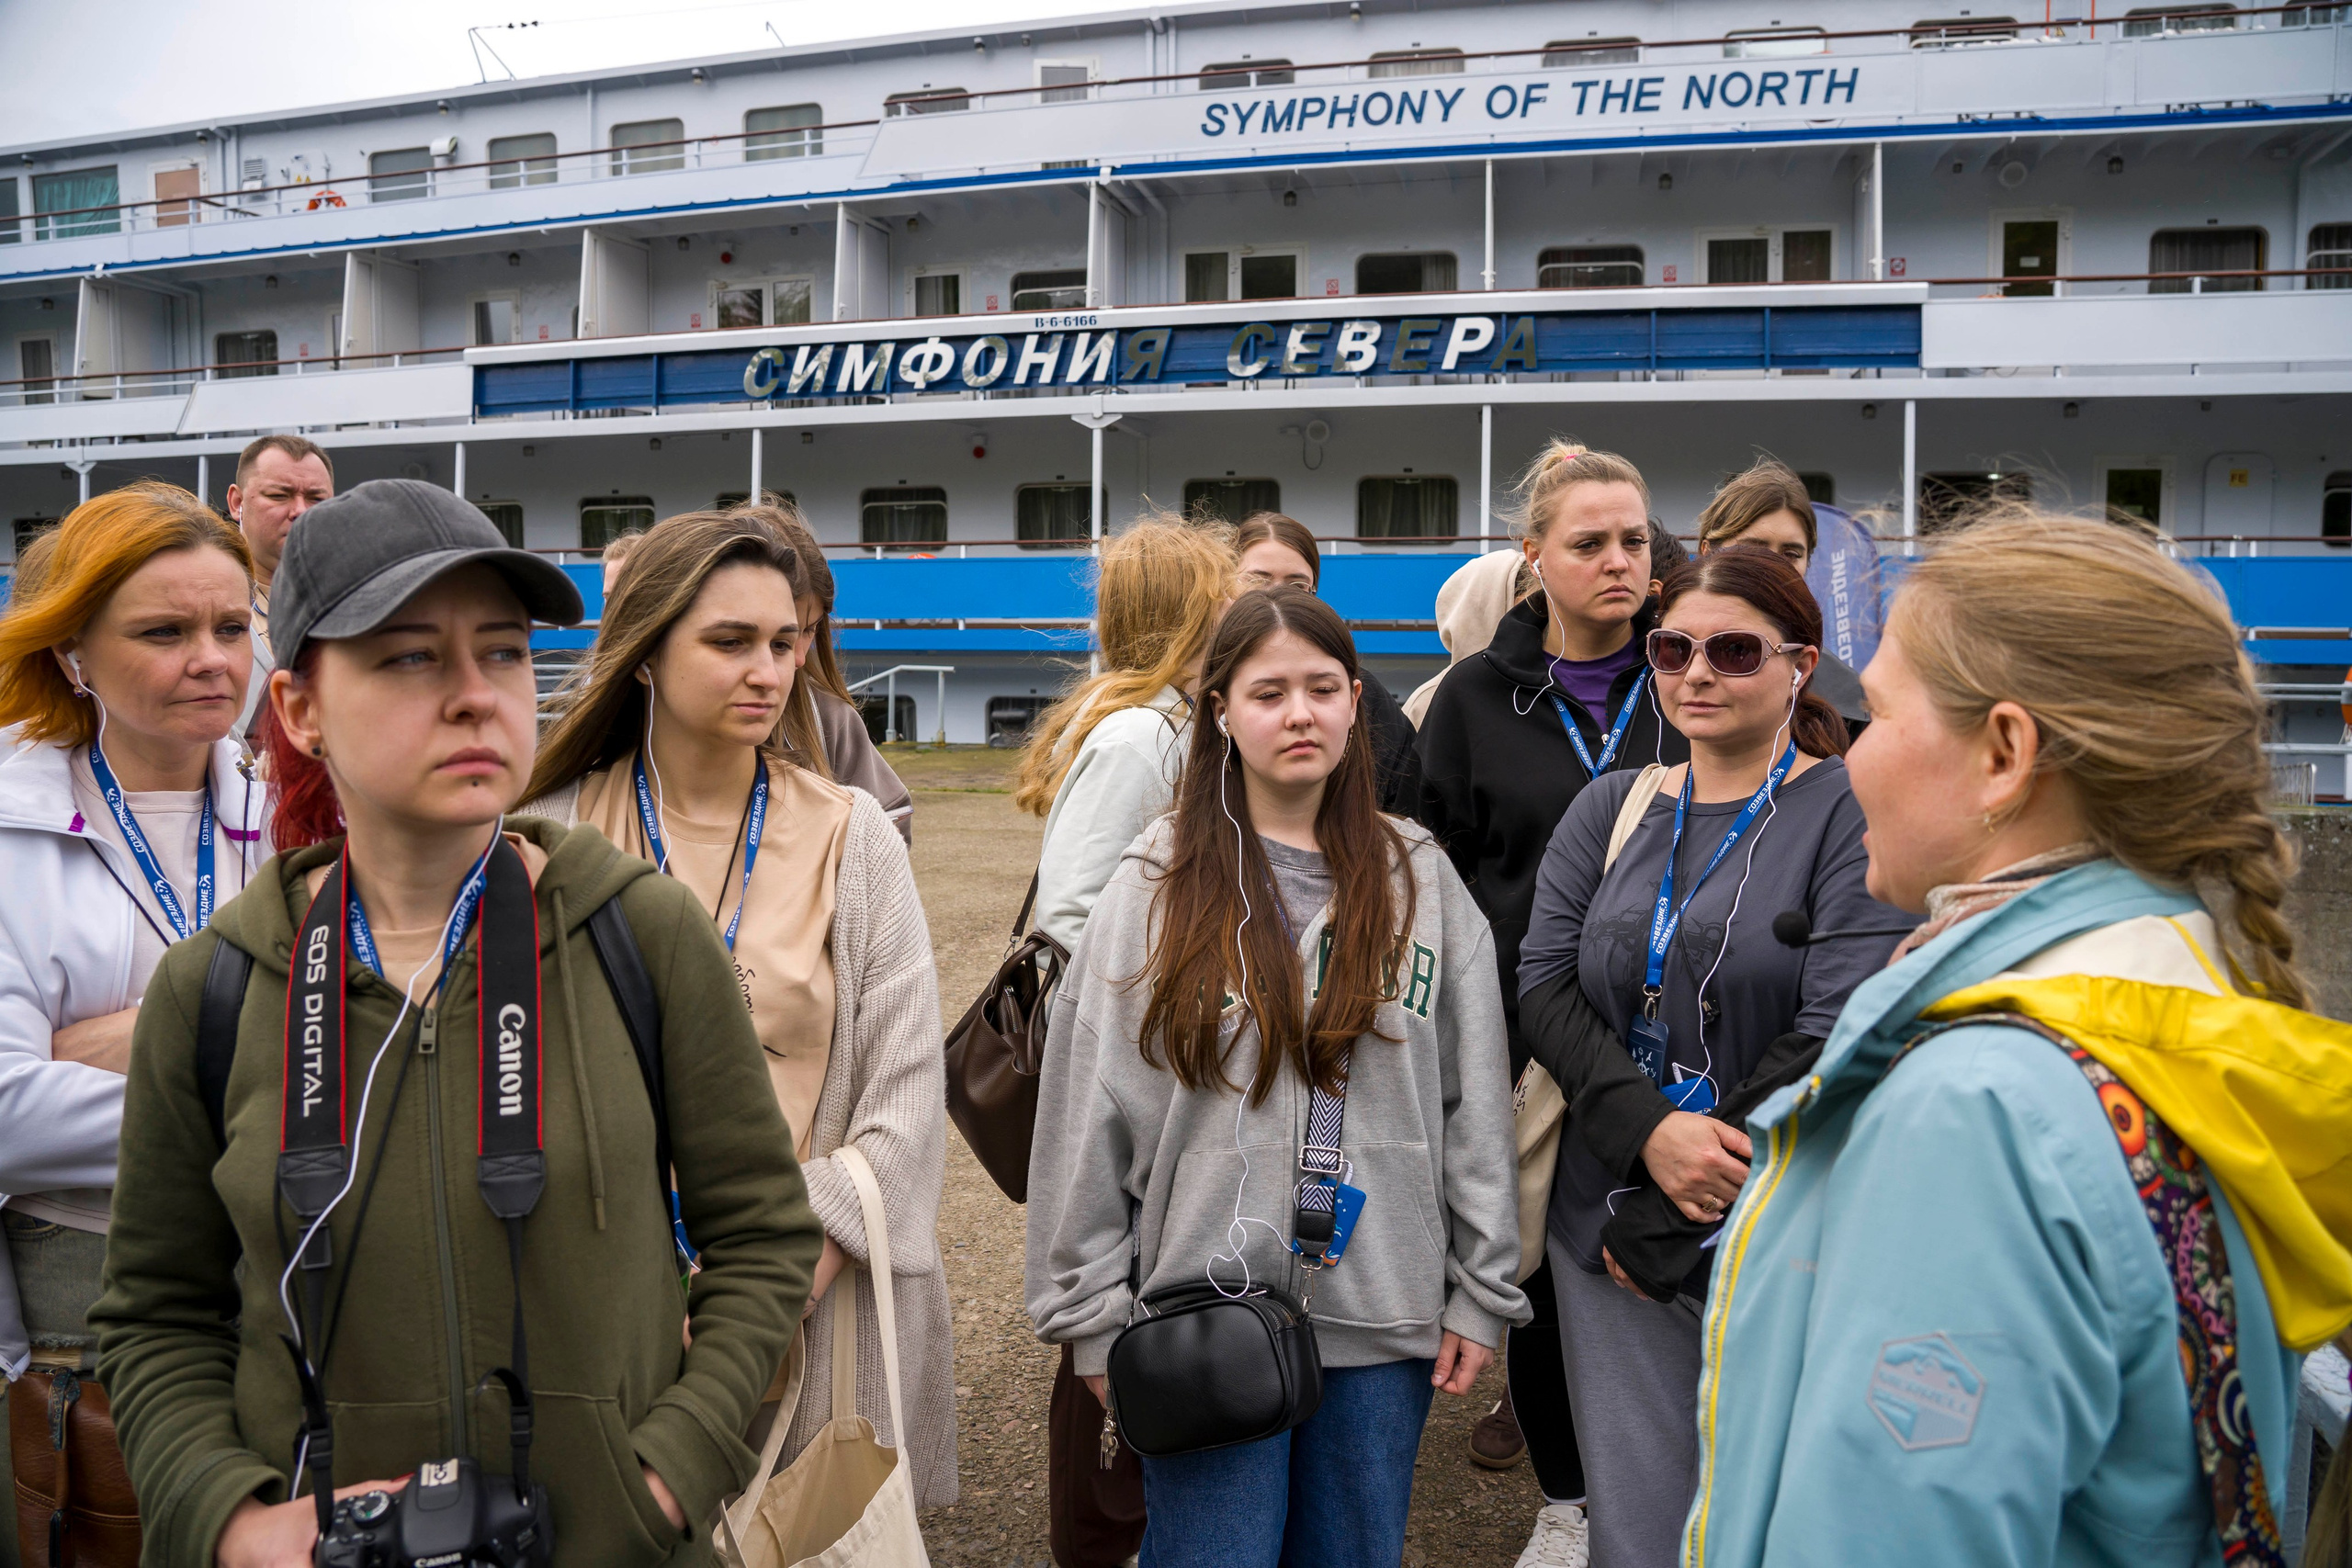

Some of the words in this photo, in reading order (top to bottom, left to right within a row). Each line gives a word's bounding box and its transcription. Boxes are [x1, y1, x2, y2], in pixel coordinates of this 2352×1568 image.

[1201, 87, 1465, 137] SYMPHONY
[1485, 83, 1549, 119] OF
[1570, 75, 1666, 116] THE
[1682, 67, 1860, 110] NORTH
[742, 328, 1172, 399] СИМФОНИЯ
[1227, 315, 1539, 378] СЕВЕРА
[639, 788, 658, 840] СОЗВЕЗДИЕ
[750, 795, 763, 845] СОЗВЕЗДИЕ
[200, 888, 209, 930] ВЕЗДИЕ
[305, 924, 330, 985] EOS
[351, 920, 375, 971] ЕЗДИЕ
[302, 993, 323, 1118] DIGITAL
[498, 1003, 526, 1116] Canon
[414, 1551, 462, 1568] Canon
